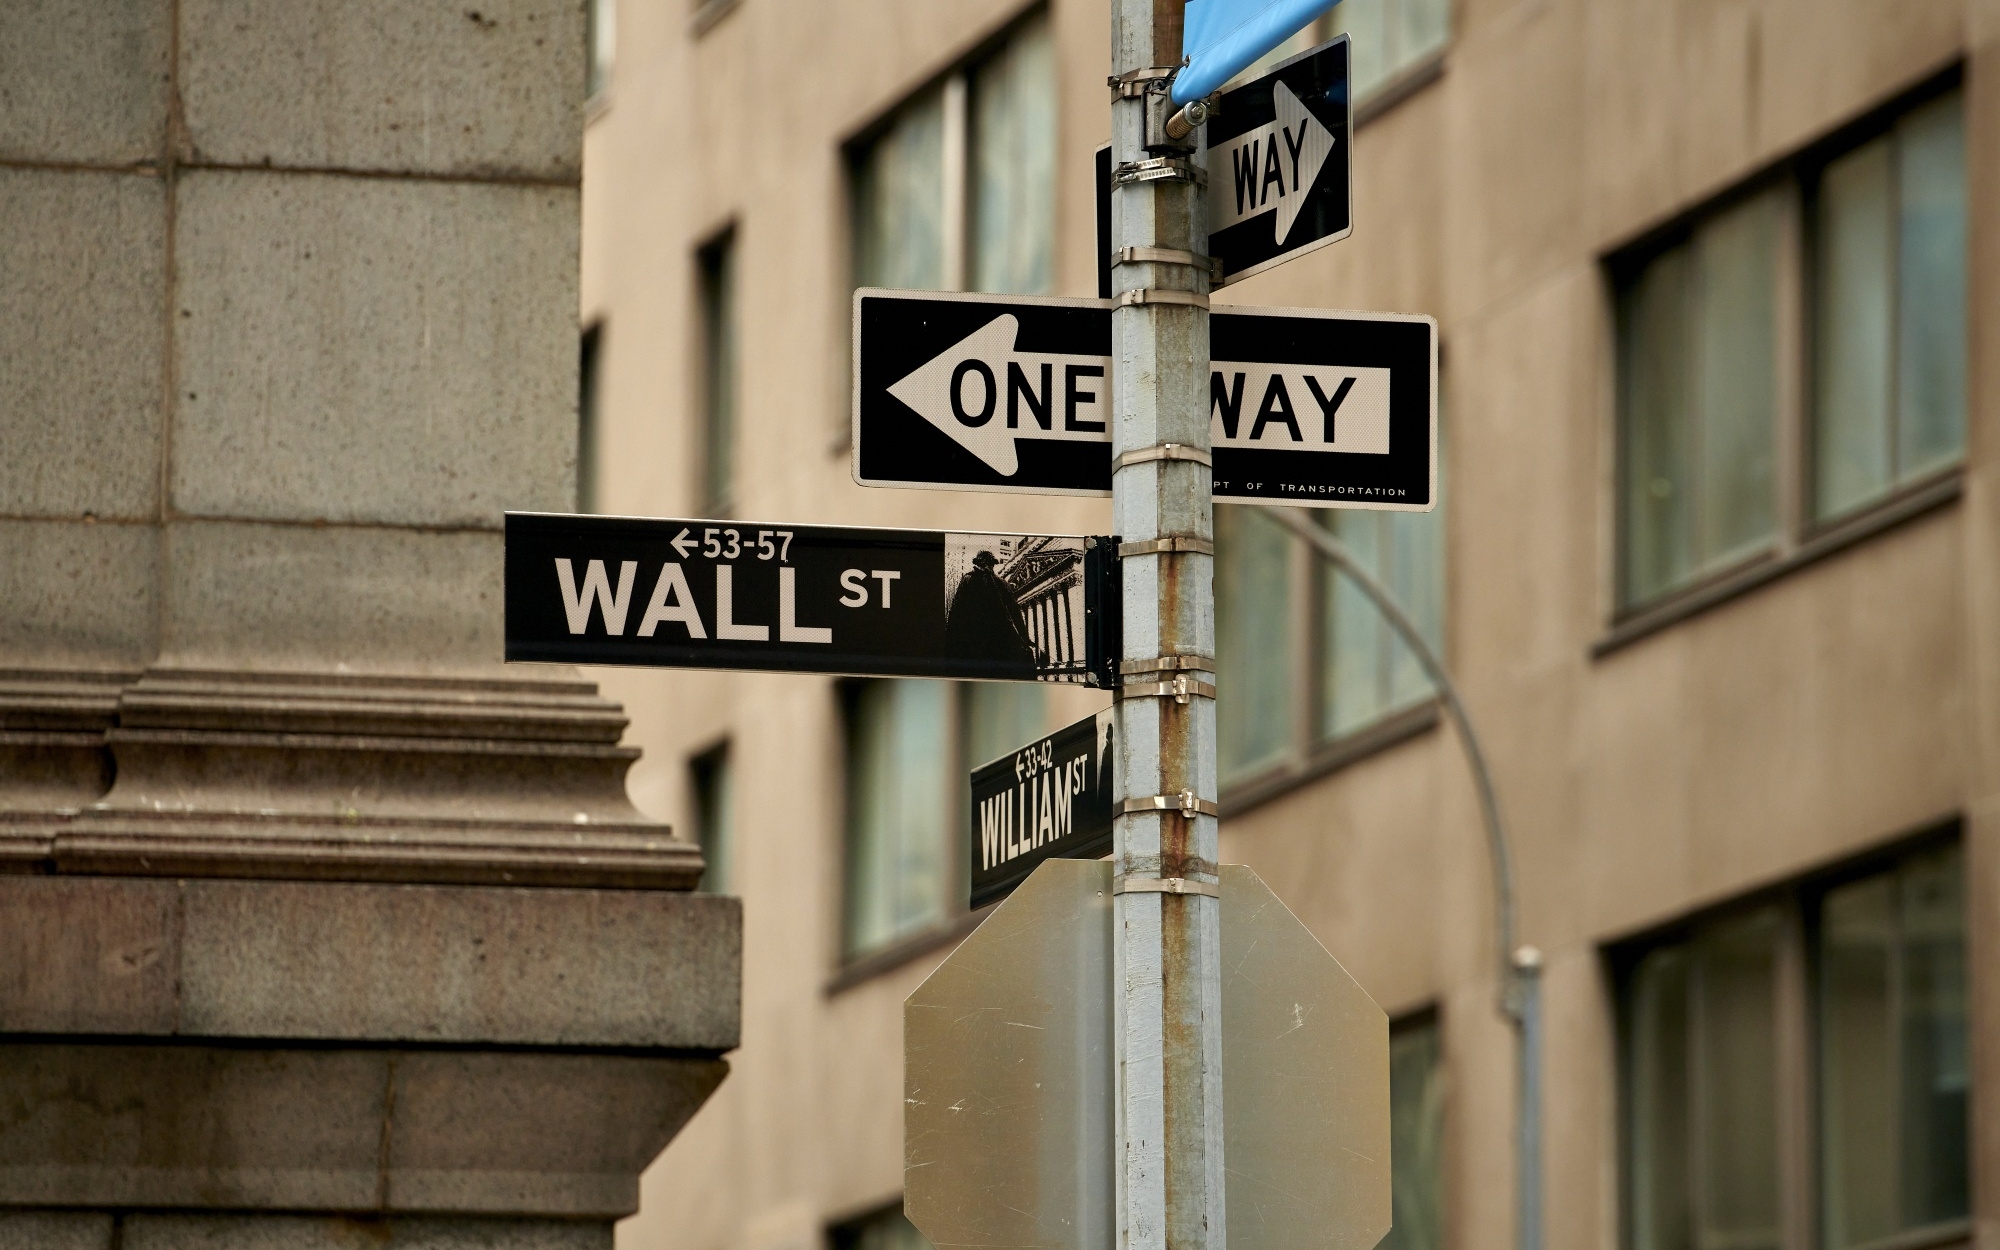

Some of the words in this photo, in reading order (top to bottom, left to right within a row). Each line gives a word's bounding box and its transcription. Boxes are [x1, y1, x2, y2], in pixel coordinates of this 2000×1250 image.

[1232, 117, 1308, 216] WAY
[949, 358, 1106, 433] ONE
[1210, 371, 1357, 443] WAY
[1213, 481, 1230, 490] PT
[1246, 482, 1264, 490] OF
[1280, 483, 1406, 496] TRANSPORTATION
[702, 528, 794, 562] 53-57
[554, 558, 833, 643] WALL
[838, 569, 901, 609] ST
[1025, 739, 1053, 779] 33-42
[980, 761, 1072, 871] WILLIAM
[1073, 753, 1088, 795] ST
